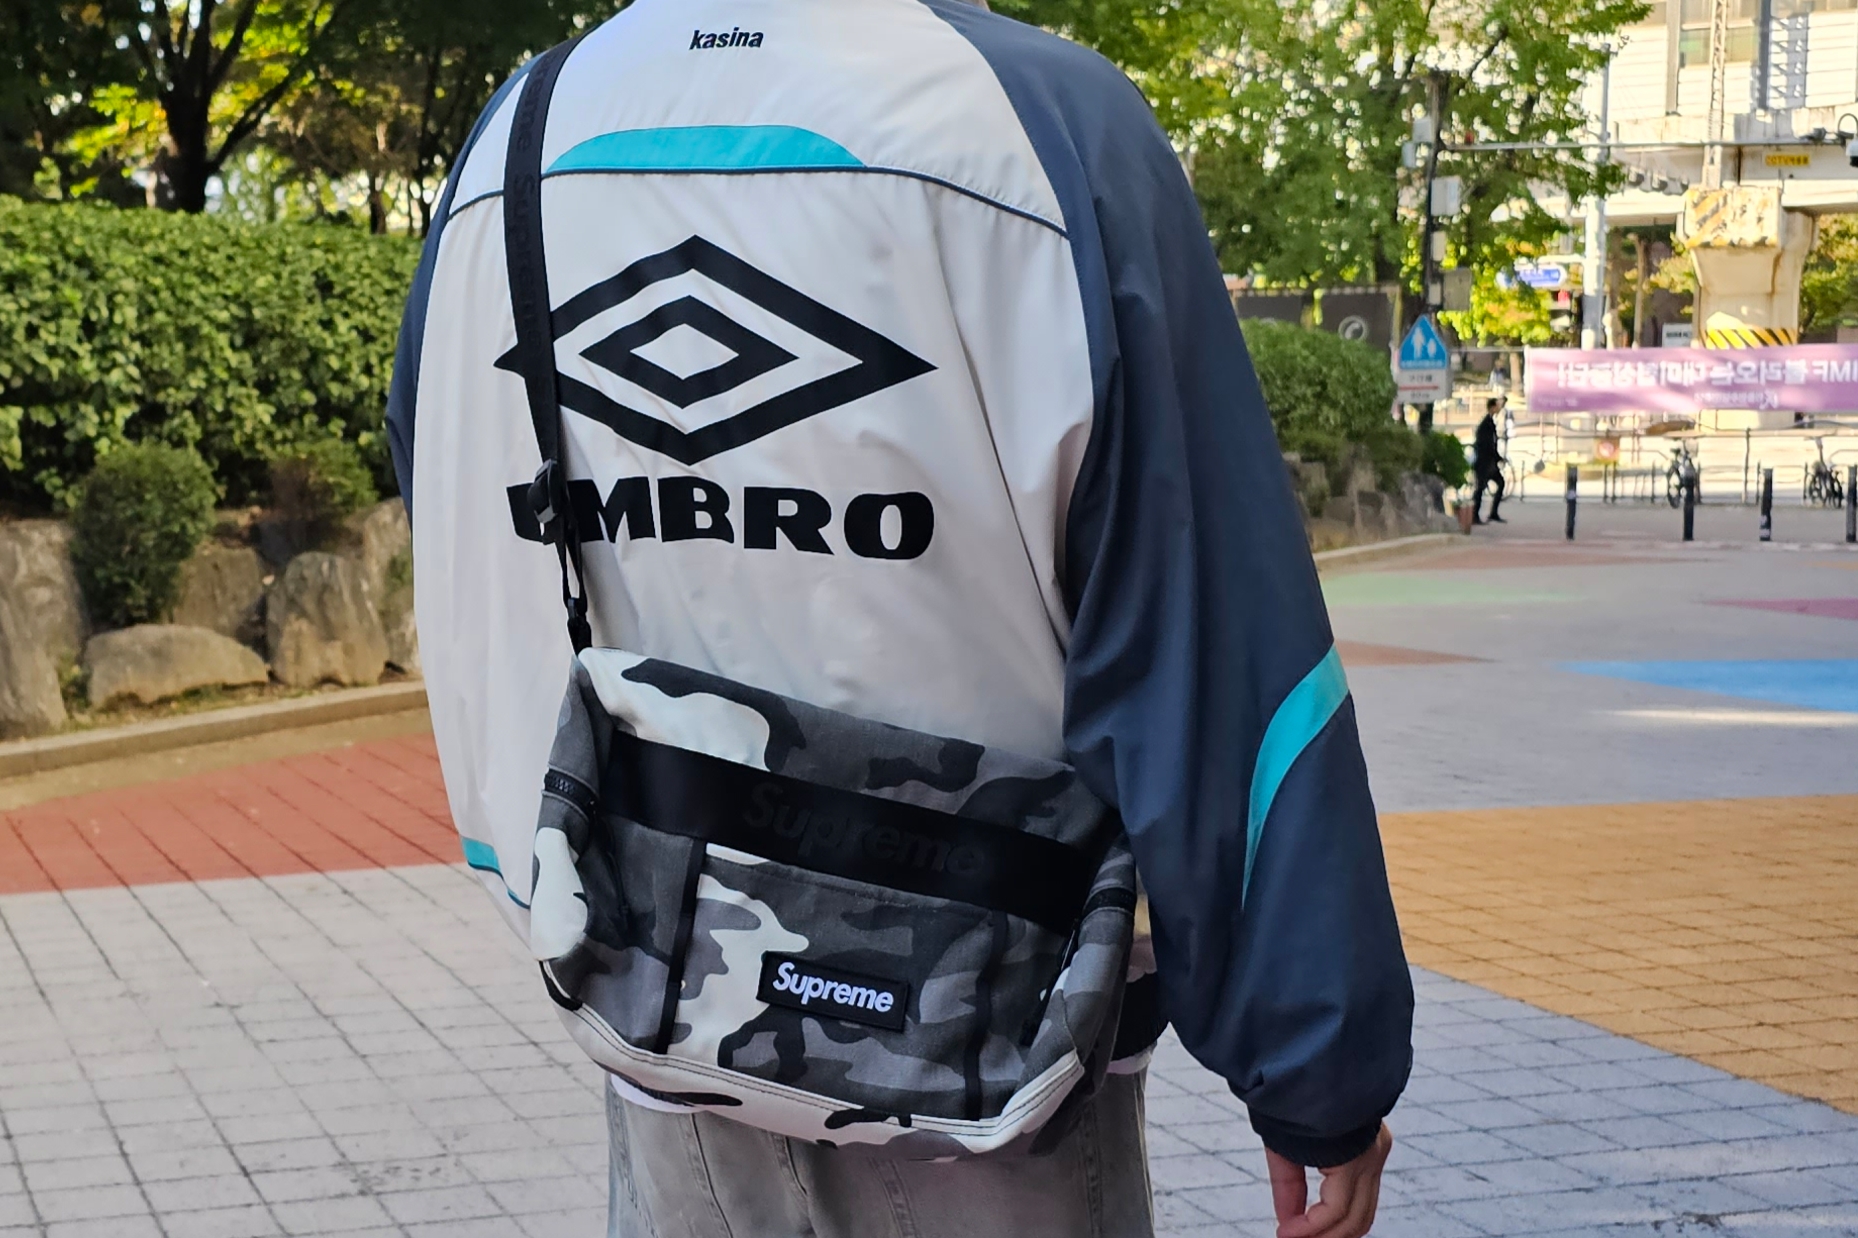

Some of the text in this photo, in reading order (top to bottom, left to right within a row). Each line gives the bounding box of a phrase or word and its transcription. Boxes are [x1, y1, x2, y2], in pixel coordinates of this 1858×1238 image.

[688, 26, 765, 51] kasina
[742, 781, 987, 876] Supreme
[772, 961, 895, 1013] Supreme
